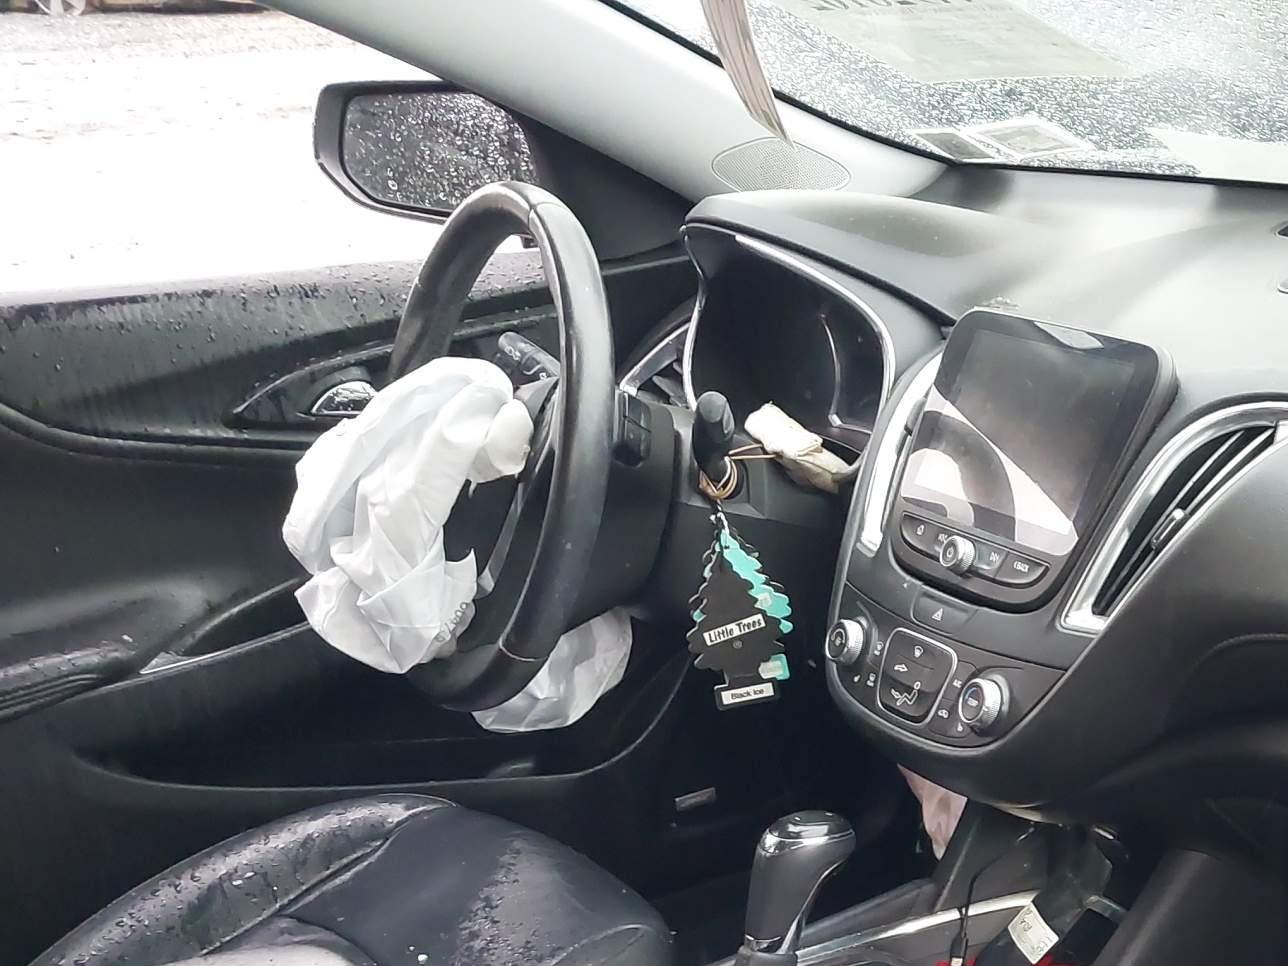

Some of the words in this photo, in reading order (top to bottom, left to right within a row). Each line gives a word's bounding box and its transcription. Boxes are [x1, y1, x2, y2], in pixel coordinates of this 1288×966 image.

[708, 626, 734, 643] Little
[735, 618, 762, 633] Trees
[731, 689, 752, 700] Black
[753, 687, 764, 697] Ice
